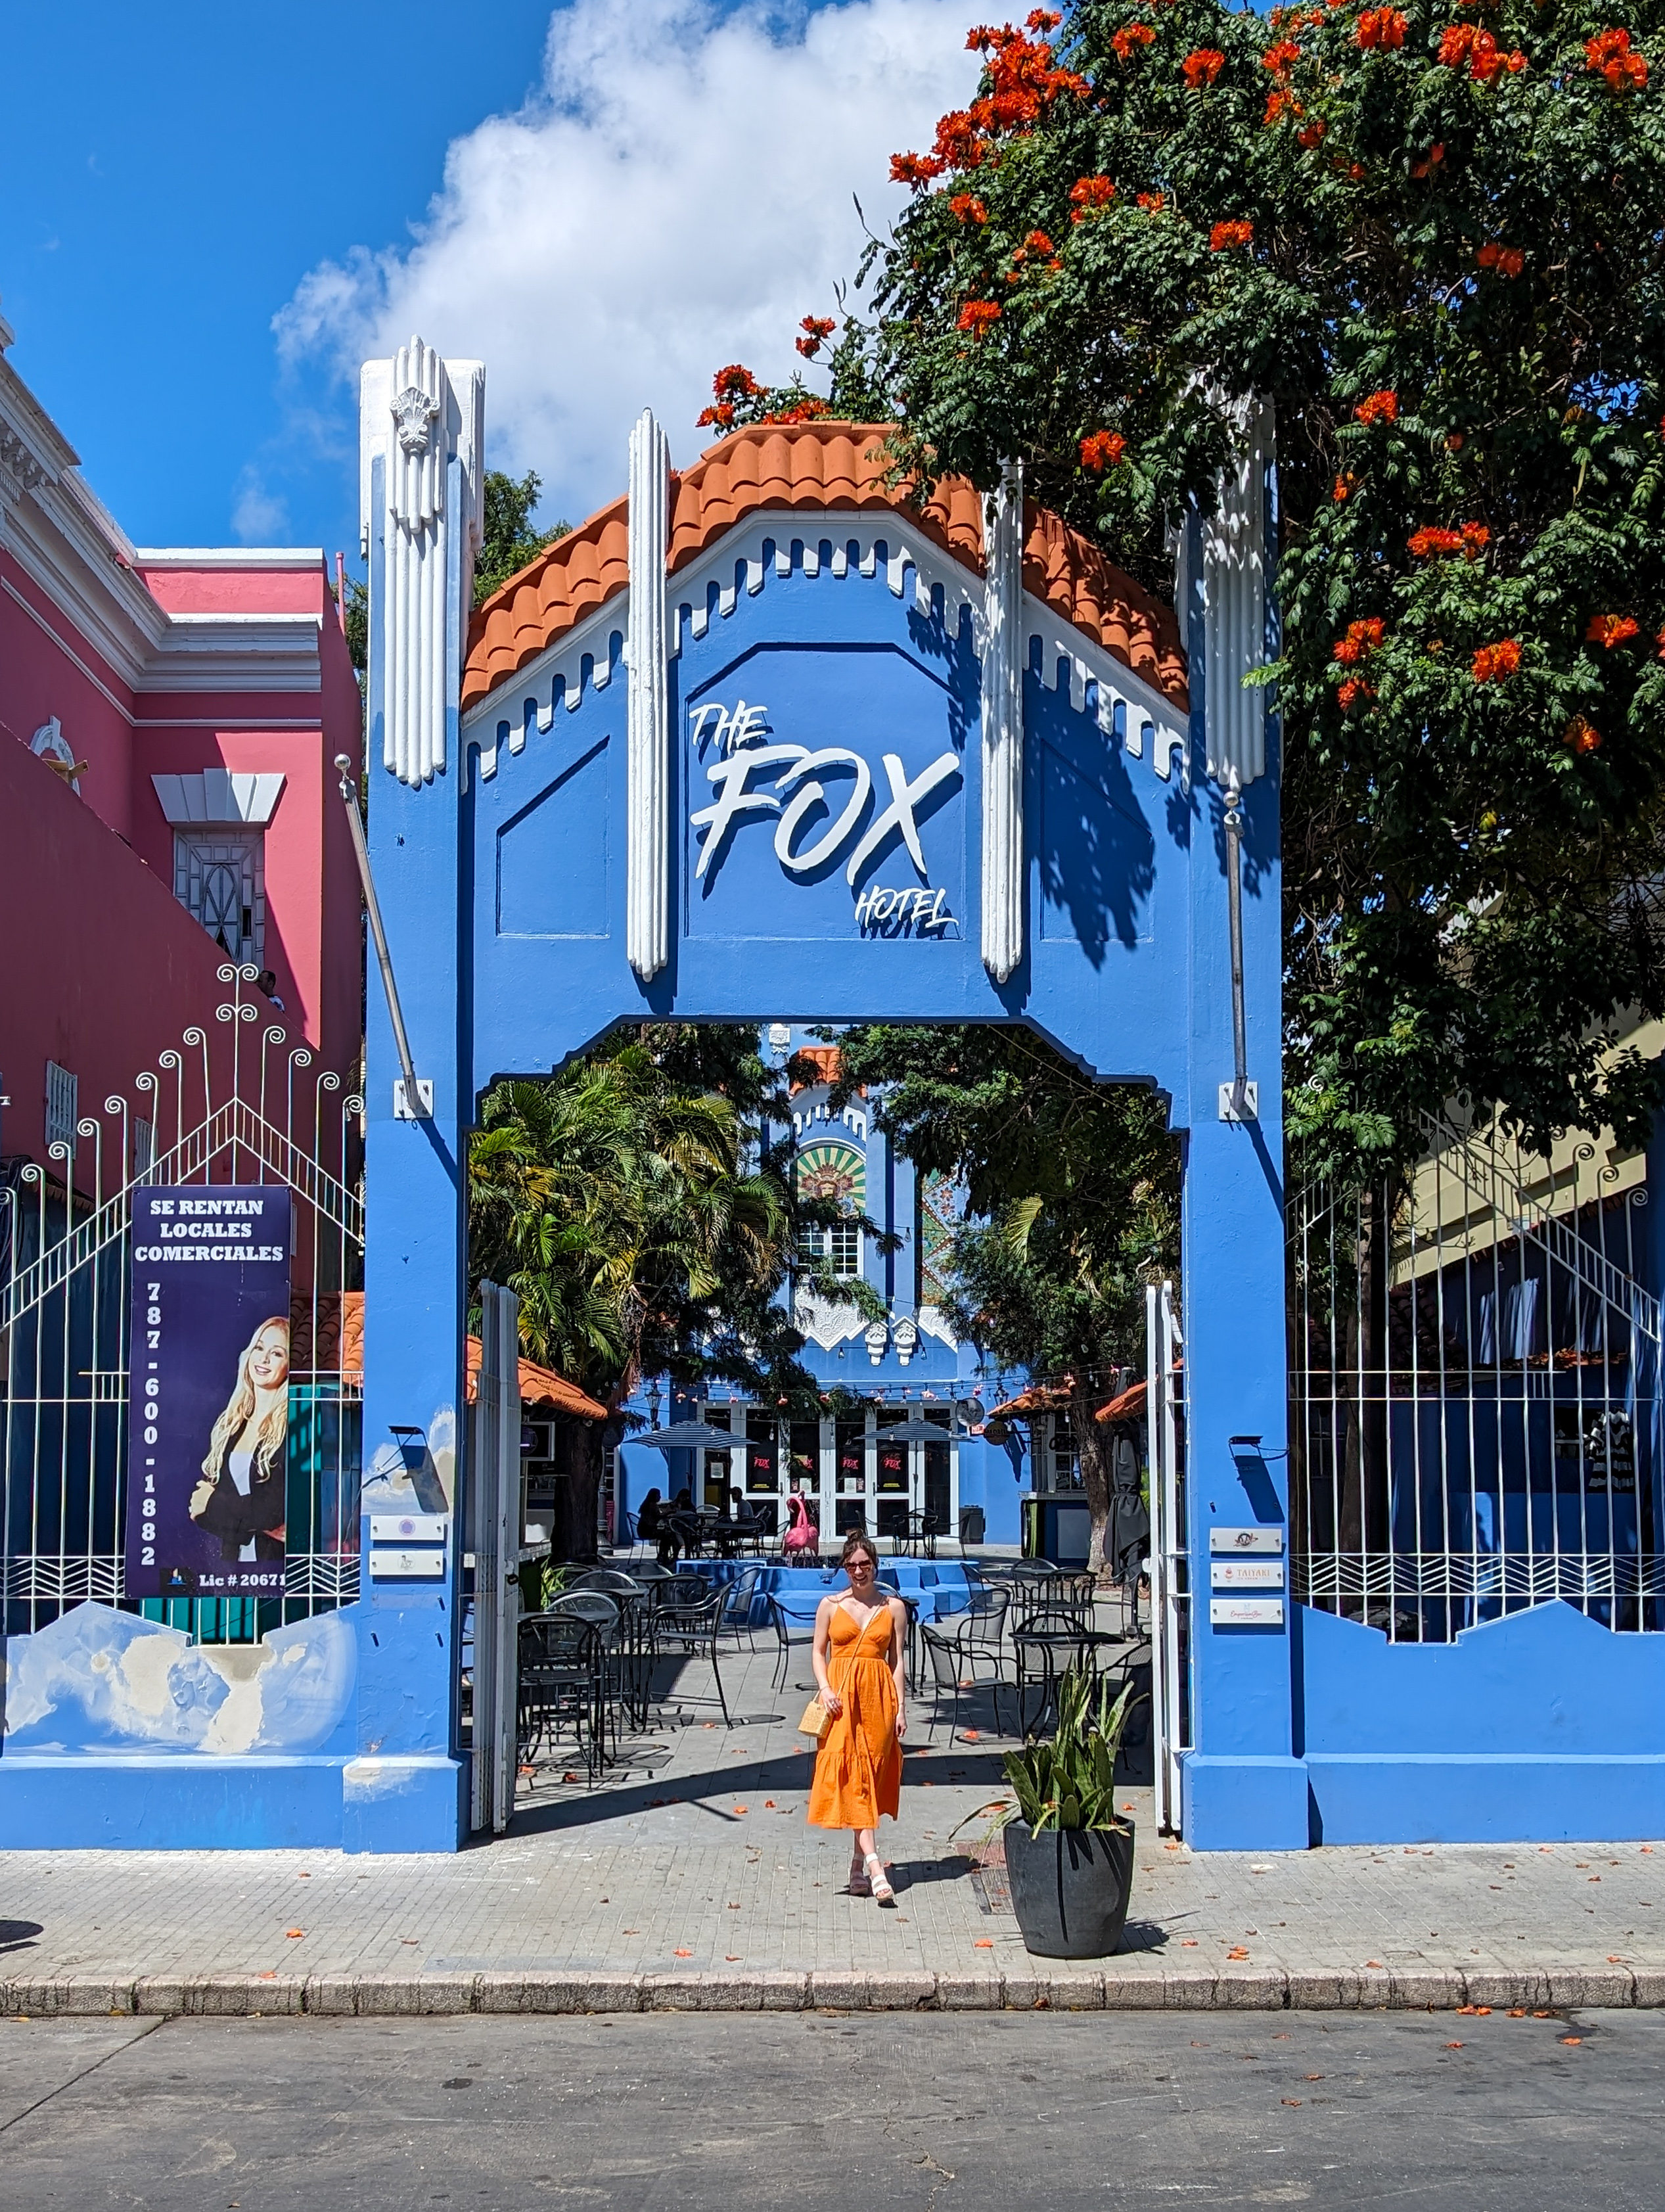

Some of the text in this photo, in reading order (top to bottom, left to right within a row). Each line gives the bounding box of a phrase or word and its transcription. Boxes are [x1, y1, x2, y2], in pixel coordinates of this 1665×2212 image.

[689, 700, 768, 755] THE
[690, 744, 961, 887] FOX
[855, 885, 959, 929] HOTEL
[150, 1199, 263, 1215] SE RENTAN
[160, 1222, 252, 1238] LOCALES
[135, 1245, 283, 1262] COMERCIALES
[199, 1573, 286, 1587] Lic # 20671
[1237, 1569, 1270, 1577] TAIYAKI
